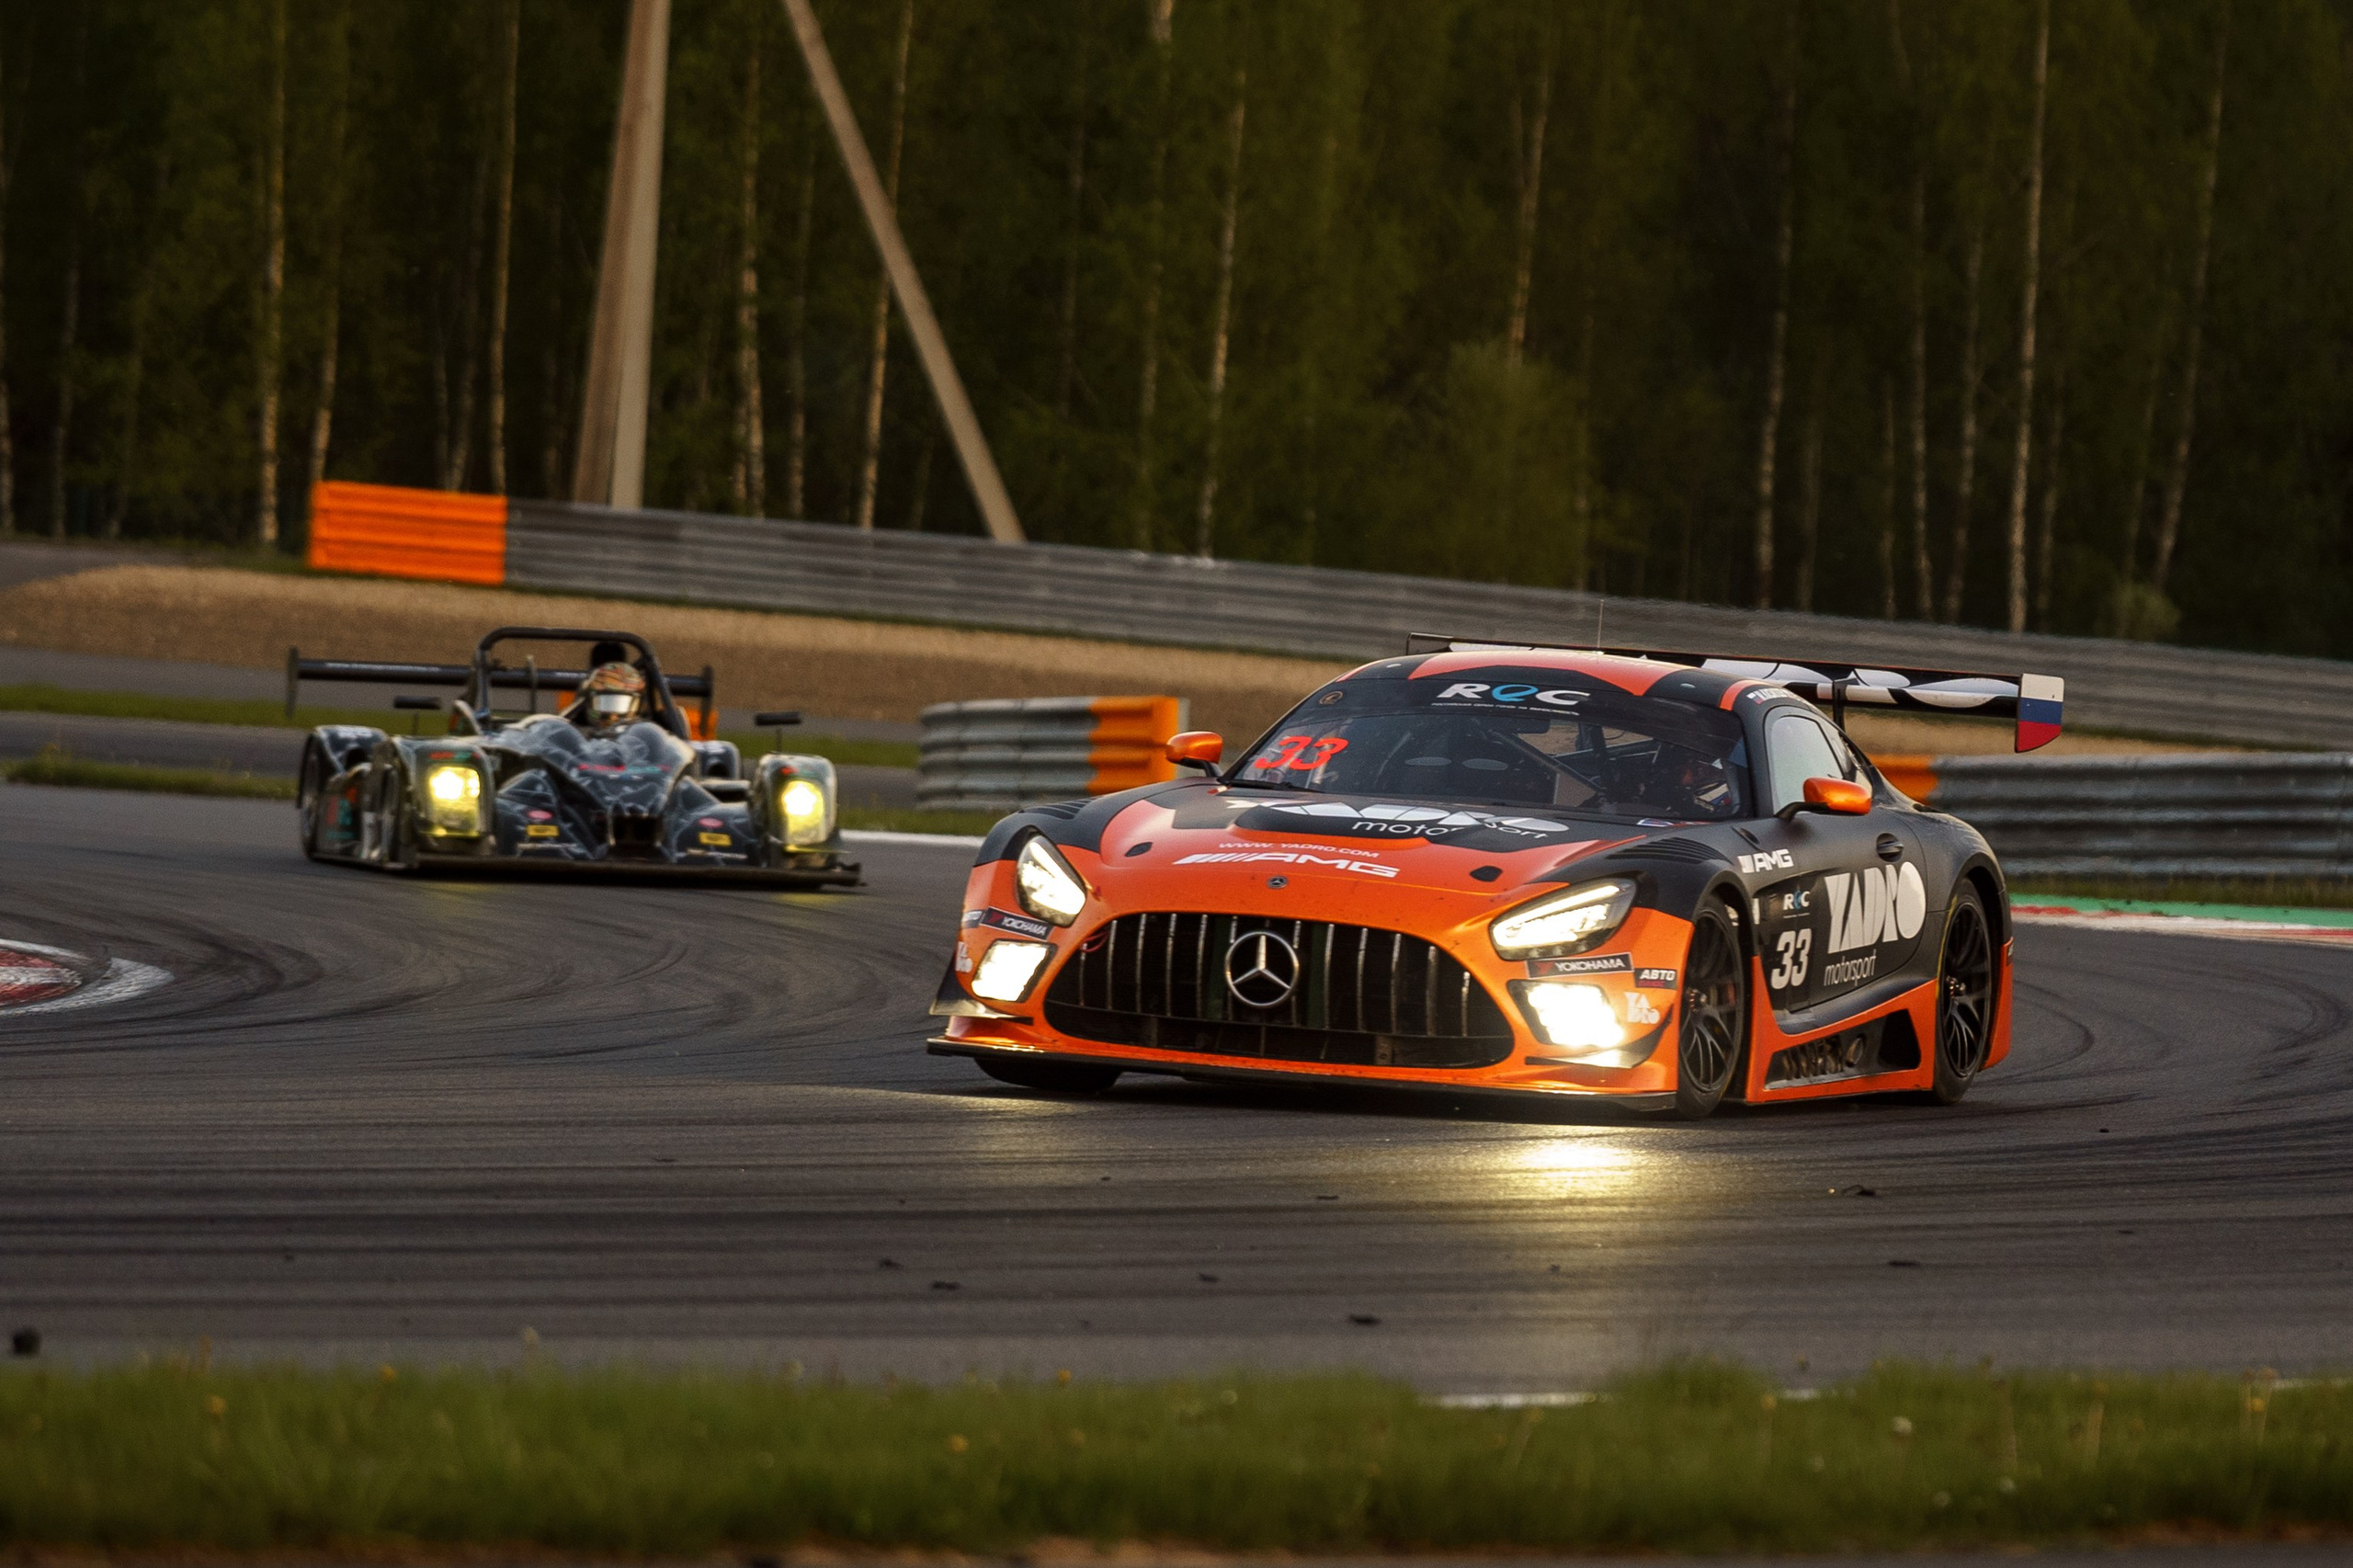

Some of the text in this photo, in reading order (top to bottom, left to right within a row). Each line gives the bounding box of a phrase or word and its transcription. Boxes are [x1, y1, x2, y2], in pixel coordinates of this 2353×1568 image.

[1255, 735, 1349, 771] 33
[1754, 848, 1794, 872] AMG
[1824, 861, 1927, 954] YADRO
[1001, 915, 1048, 937] YOKOHAMA
[1554, 958, 1626, 971] YOKOHAMA
[1771, 927, 1813, 990] 33
[1824, 949, 1877, 987] motorsport
[1640, 969, 1676, 981] АВТО
